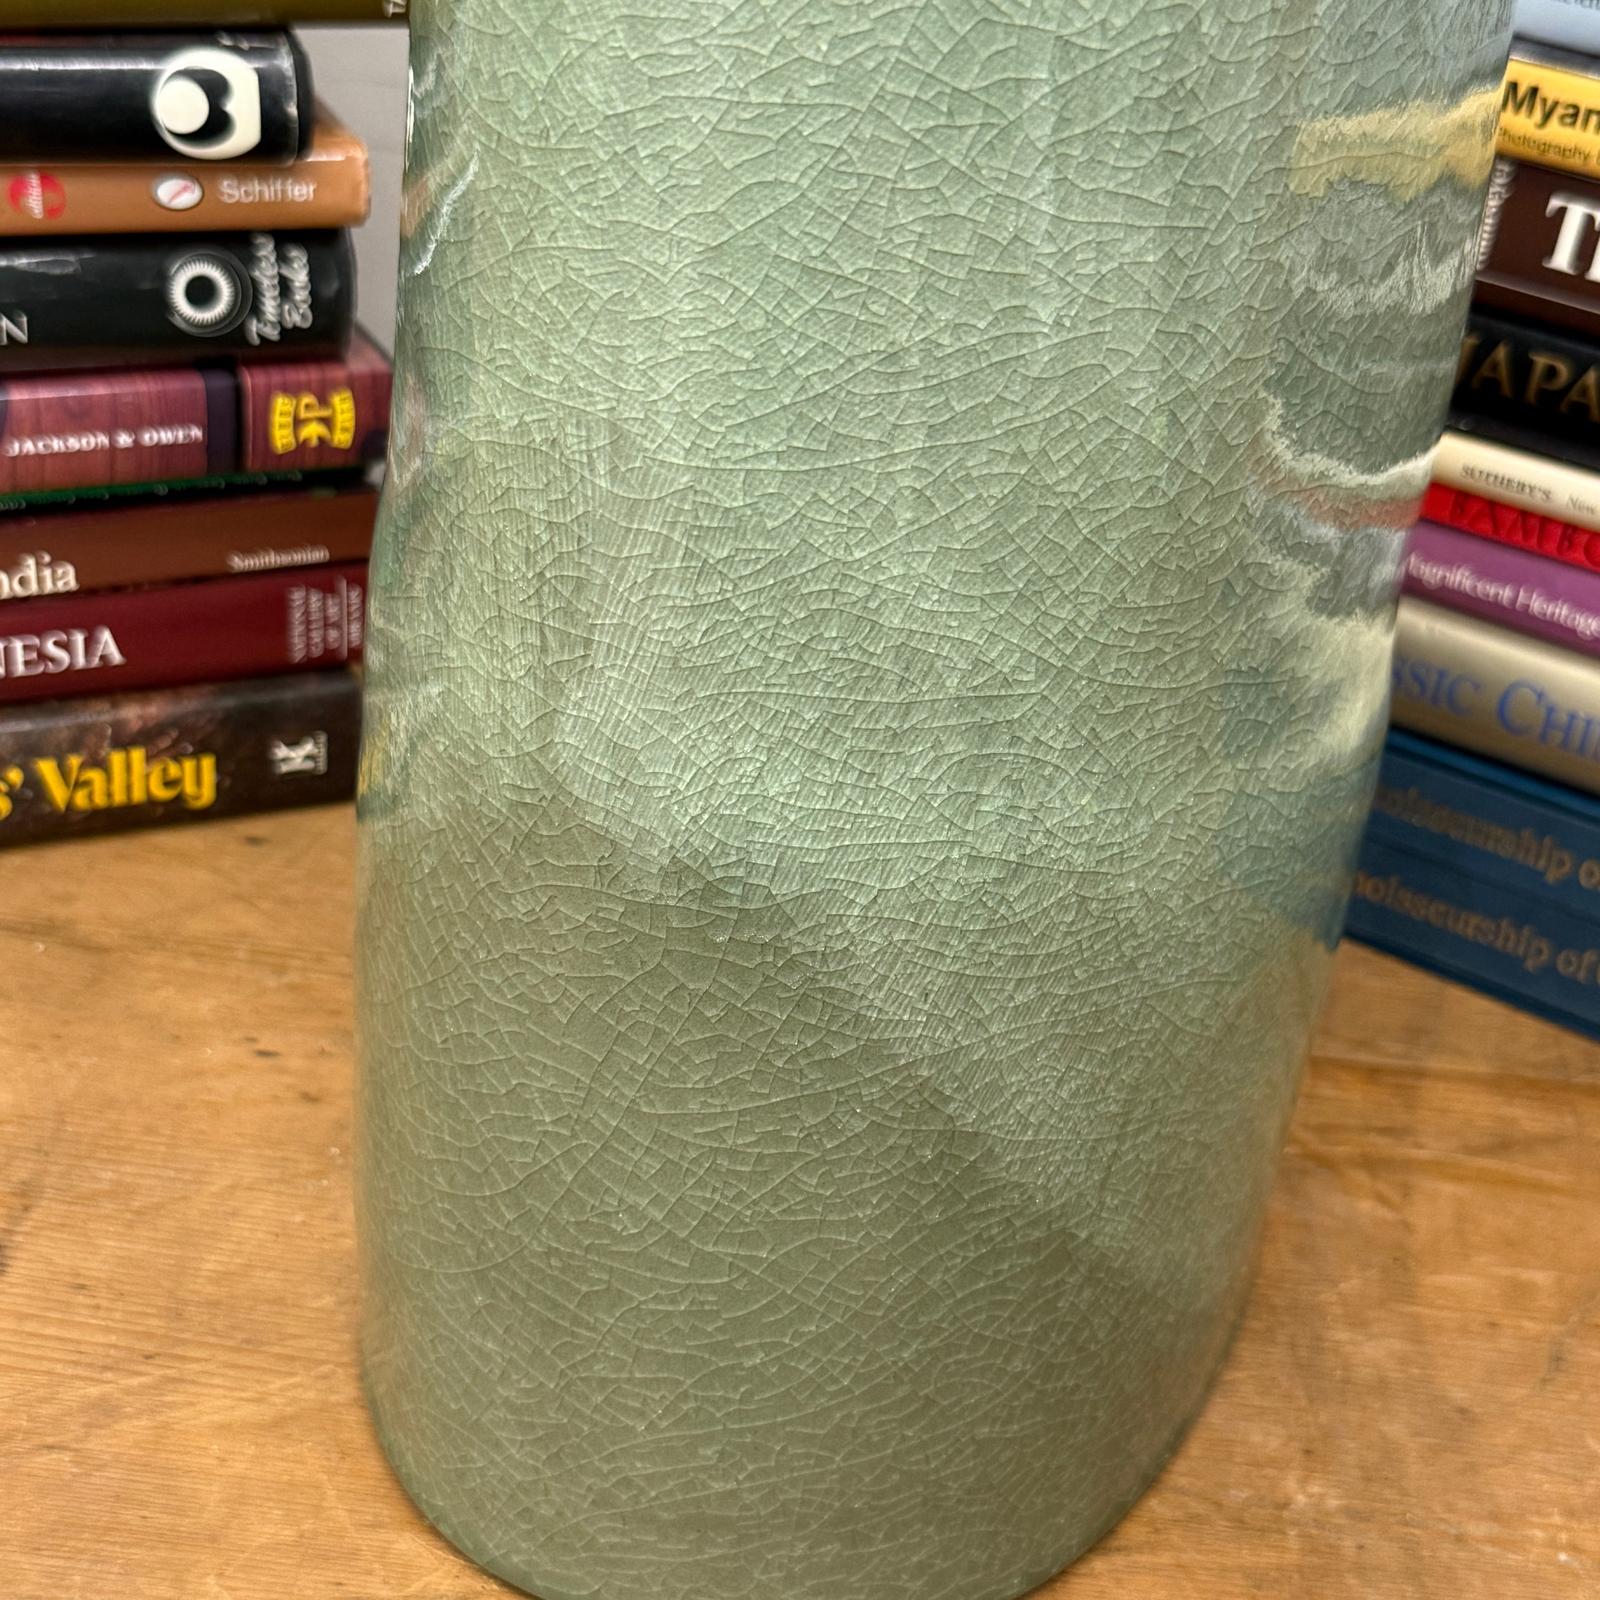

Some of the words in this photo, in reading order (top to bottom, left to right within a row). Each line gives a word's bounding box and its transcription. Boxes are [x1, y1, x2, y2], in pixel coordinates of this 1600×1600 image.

[219, 174, 317, 203] Schiffer
[4, 430, 110, 457] JACKSON
[138, 424, 203, 447] OWEN
[34, 746, 216, 813] Valley
